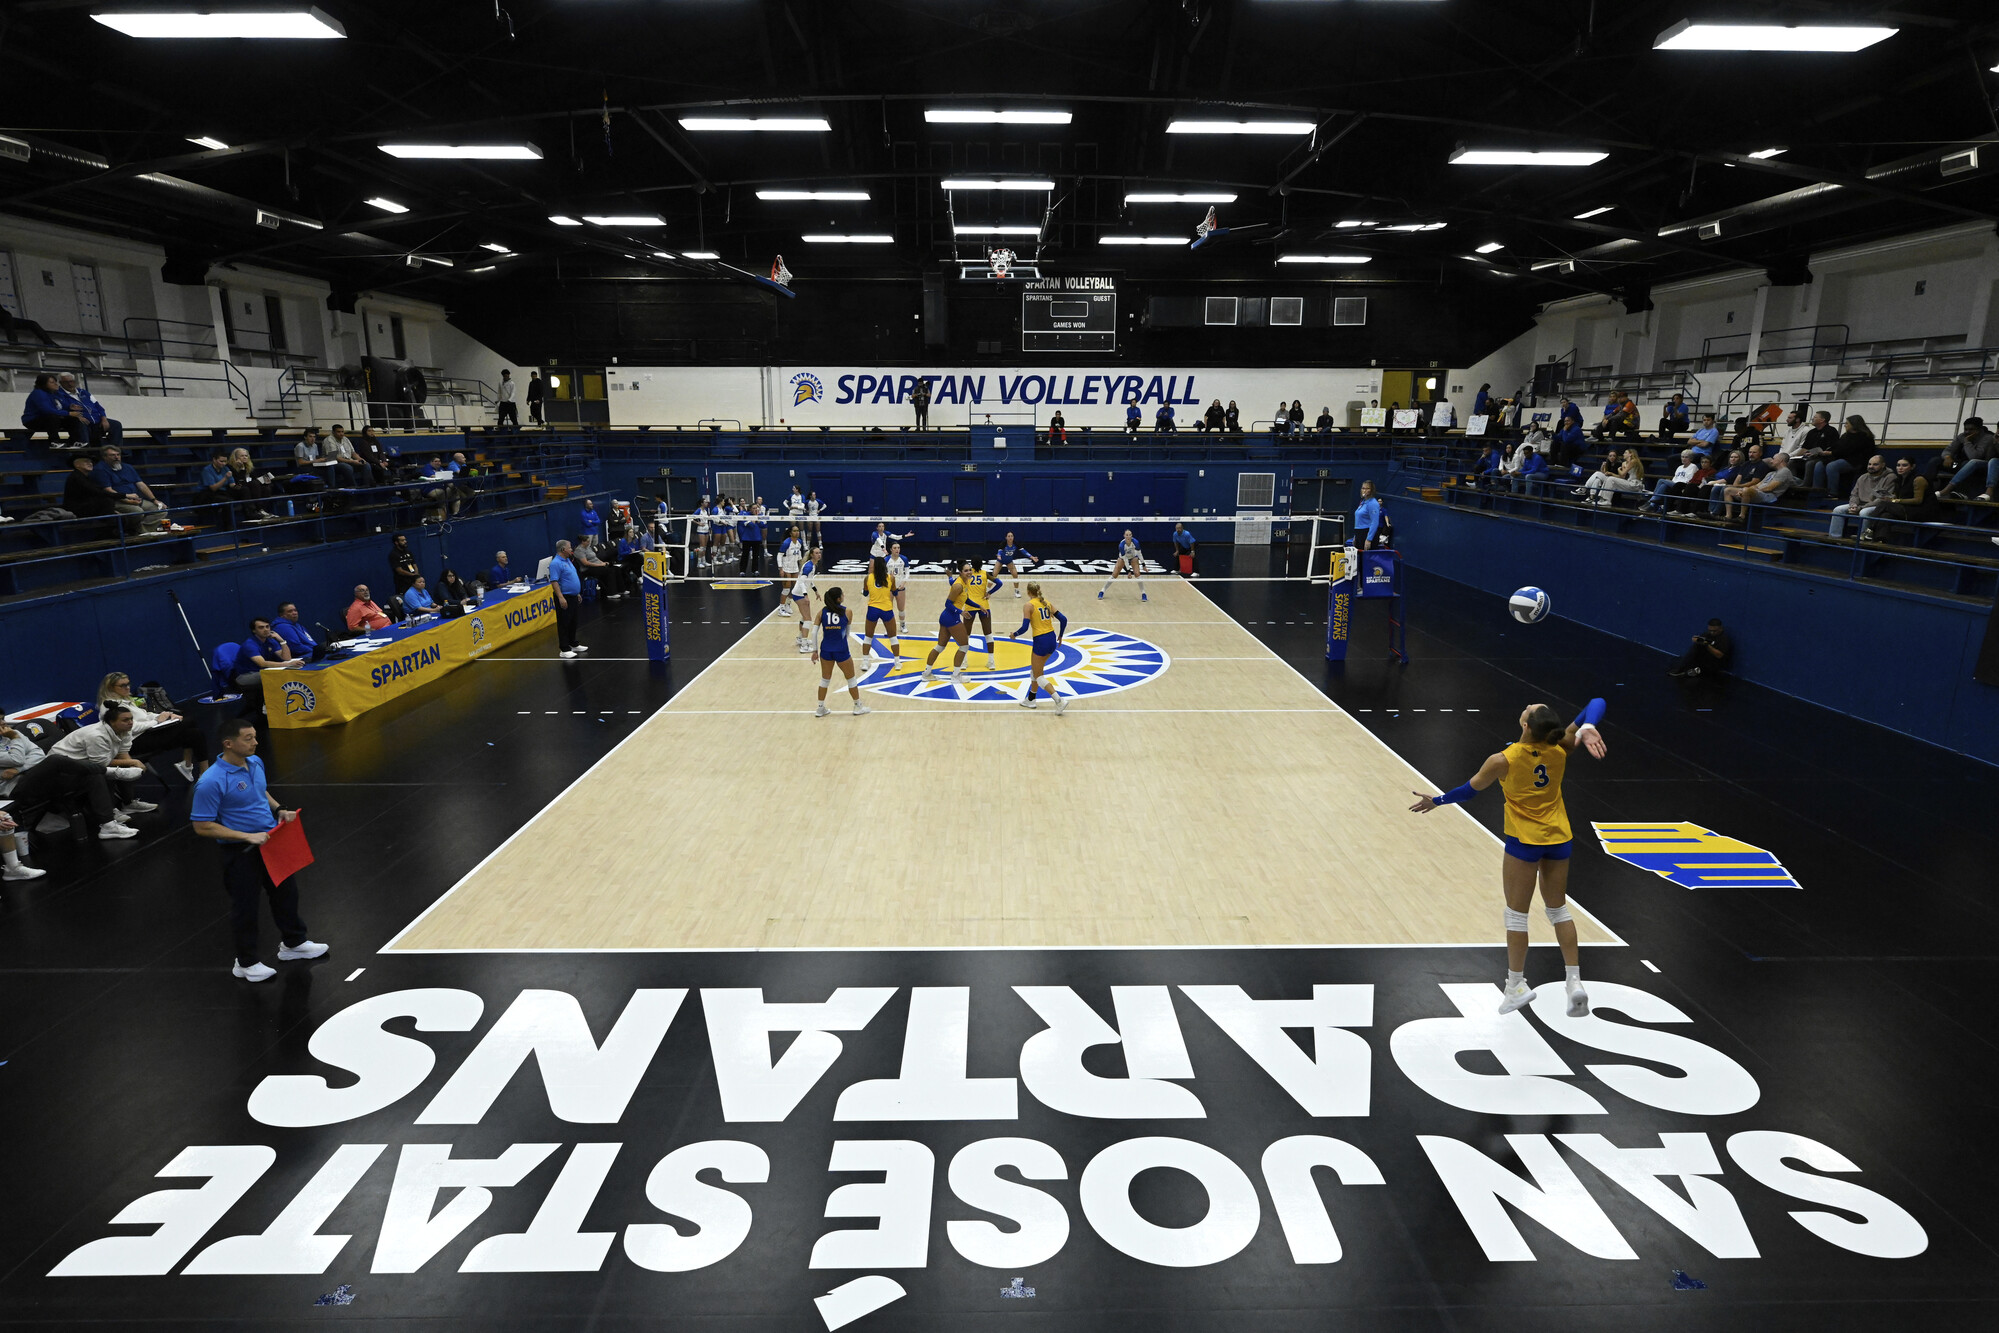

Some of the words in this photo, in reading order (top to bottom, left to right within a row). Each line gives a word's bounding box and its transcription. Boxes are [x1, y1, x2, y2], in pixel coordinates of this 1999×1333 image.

[1064, 277, 1115, 289] VOLLEYBALL
[835, 374, 985, 404] SPARTAN
[1000, 374, 1201, 405] VOLLEYBALL
[970, 575, 983, 586] 25
[1342, 593, 1350, 607] SAN
[651, 593, 662, 641] SPARTANS
[826, 612, 840, 625] 16
[1038, 607, 1051, 620] 10
[1332, 592, 1343, 640] SPARTANS
[371, 643, 441, 688] SPARTAN
[504, 596, 556, 630] VOLLEYBA
[1533, 763, 1550, 788] 3
[248, 981, 1760, 1127] SPARTANS
[46, 1140, 770, 1276] STATE
[1416, 1131, 1928, 1261] SAN
[812, 1135, 1386, 1332] JOSÉ
